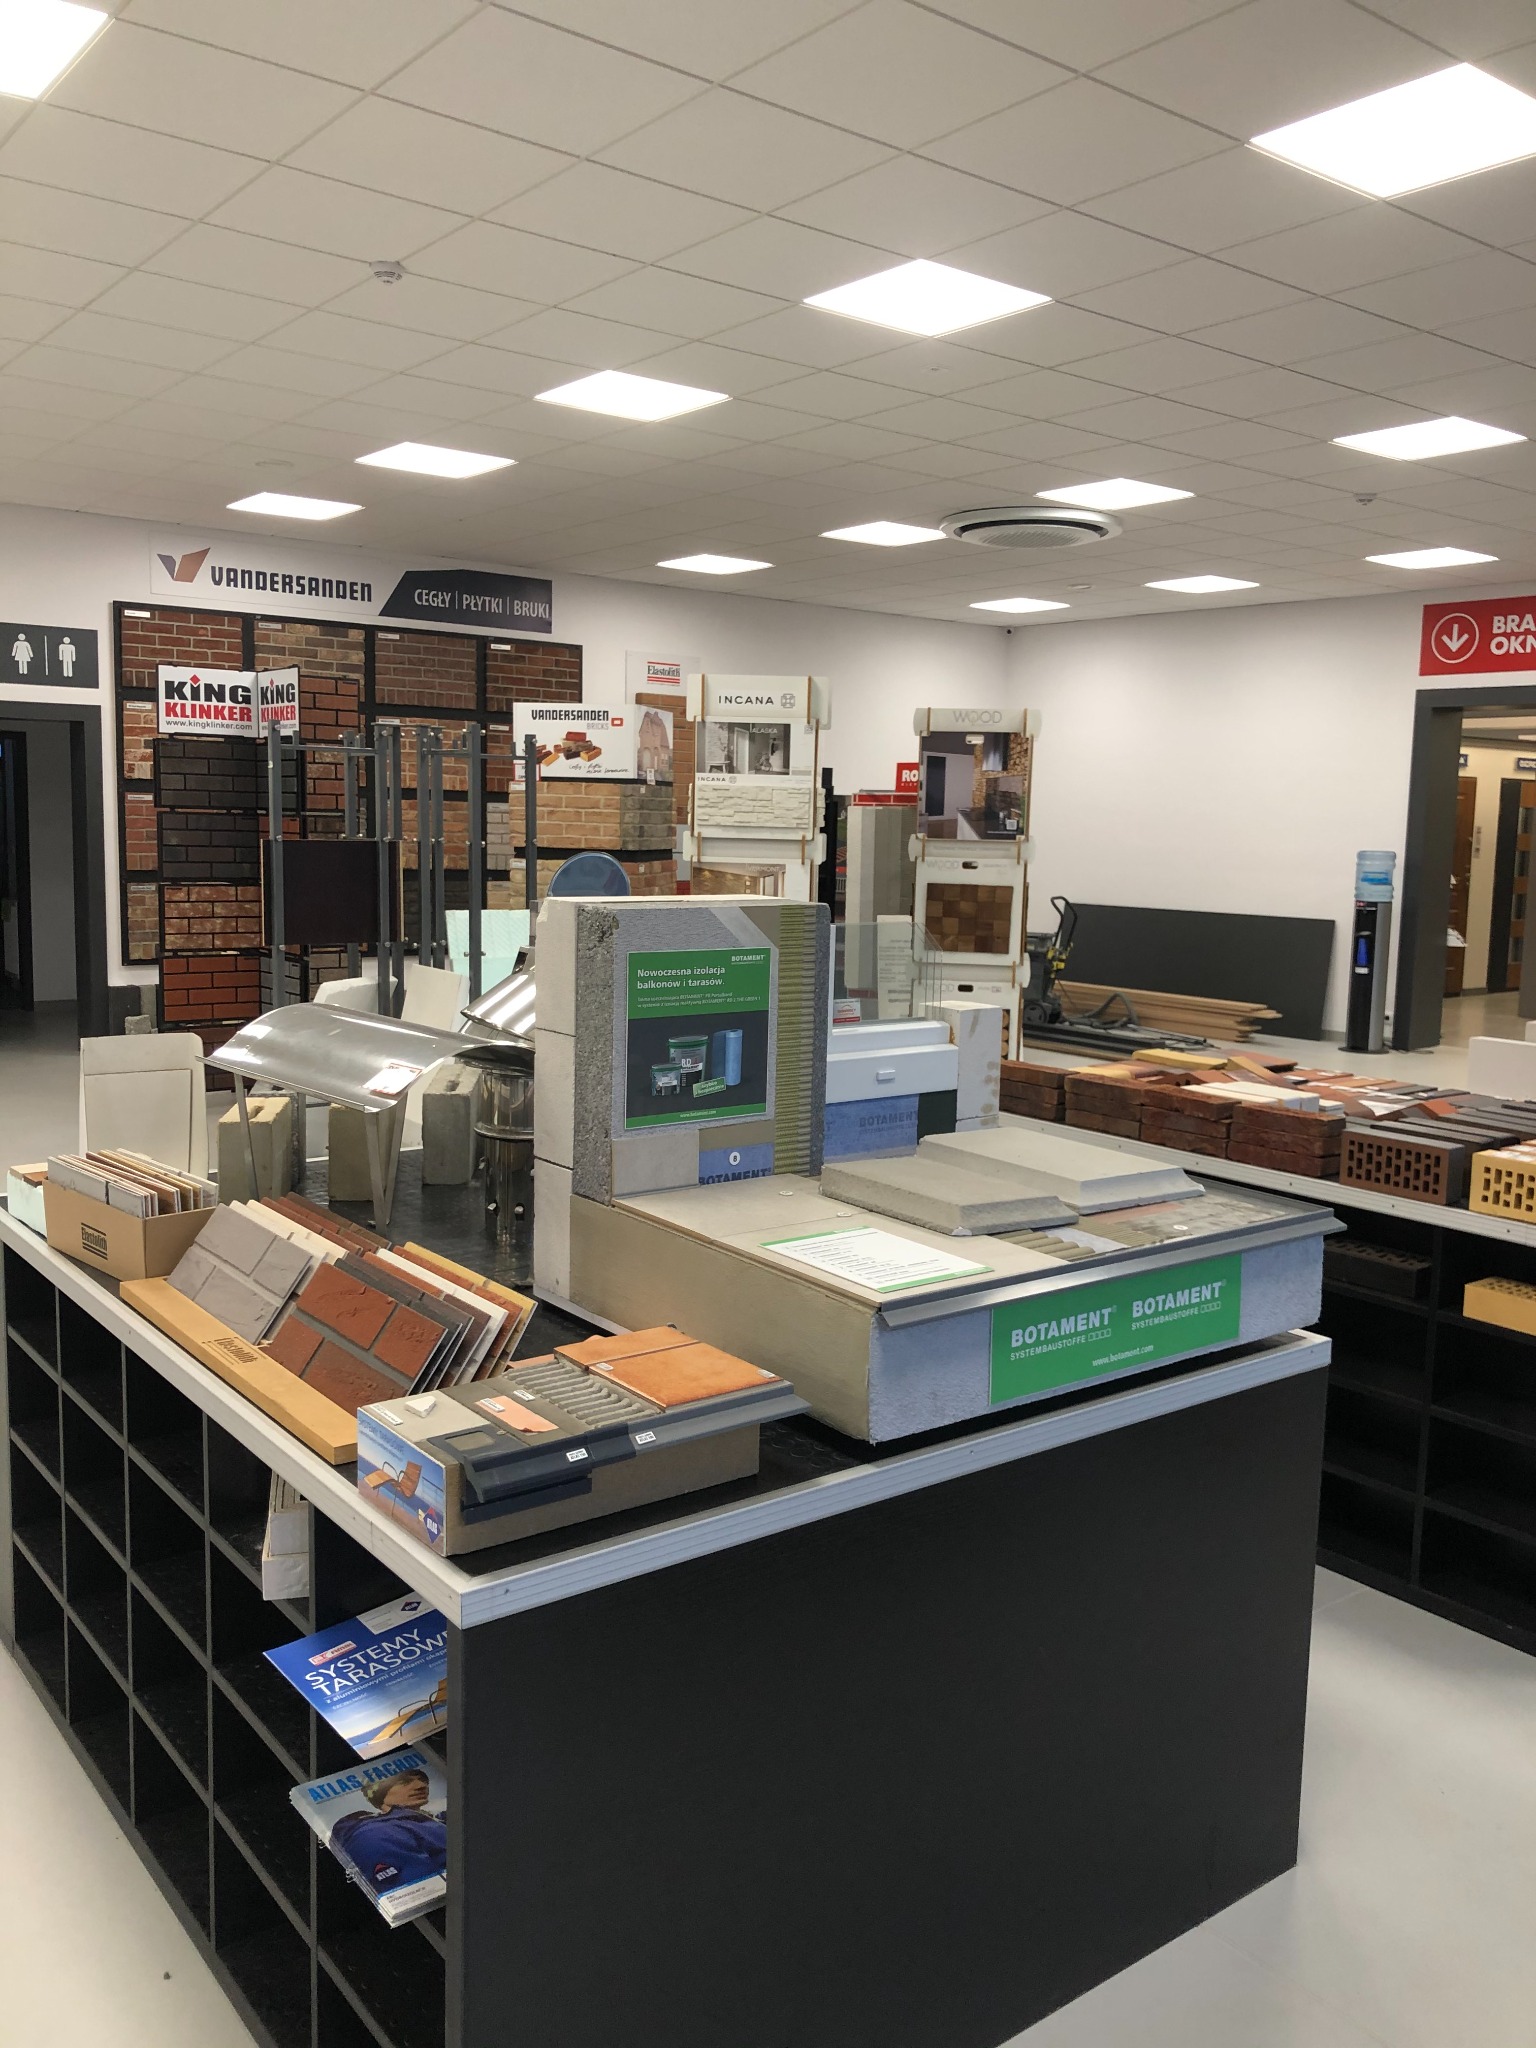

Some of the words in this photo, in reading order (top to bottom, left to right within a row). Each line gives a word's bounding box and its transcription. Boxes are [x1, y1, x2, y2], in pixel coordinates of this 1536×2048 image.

[210, 565, 372, 603] VANDERSANDEN
[414, 588, 452, 608] CEGŁY
[462, 594, 503, 614] PŁYTKI
[513, 599, 550, 619] BRUKI
[164, 675, 252, 706] KING
[260, 680, 296, 706] KING
[718, 695, 775, 705] INCANA
[164, 701, 252, 722] KLINKER
[261, 704, 297, 723] KLINKER
[531, 709, 609, 721] VANDERSANDEN
[953, 710, 1003, 725] WOOD
[165, 720, 253, 731] www.kingklinker.com
[586, 722, 609, 730] BRICKS
[697, 775, 727, 783] INCANA
[731, 954, 765, 962] BOTAMENT
[637, 967, 692, 978] Nowoczesna
[693, 965, 726, 977] izolacja
[637, 979, 681, 989] balkonów
[683, 978, 687, 988] i
[688, 976, 725, 988] tarasów.
[81, 1226, 108, 1252] Elastolith
[1132, 1282, 1223, 1318] BOTAMENT
[1011, 1307, 1112, 1348] BOTAMENT
[1131, 1306, 1200, 1331] SYSTEMBAUSTOFFE
[1010, 1334, 1086, 1361] SYSTEMBAUSTOFFE
[1092, 1344, 1154, 1367] www.botament.com
[305, 1628, 421, 1686] SYSTEMY
[333, 1673, 390, 1702] aluminiowymi
[390, 1658, 425, 1677] profilami
[307, 1773, 364, 1802] ATLAS
[375, 1866, 398, 1882] ATLAS
